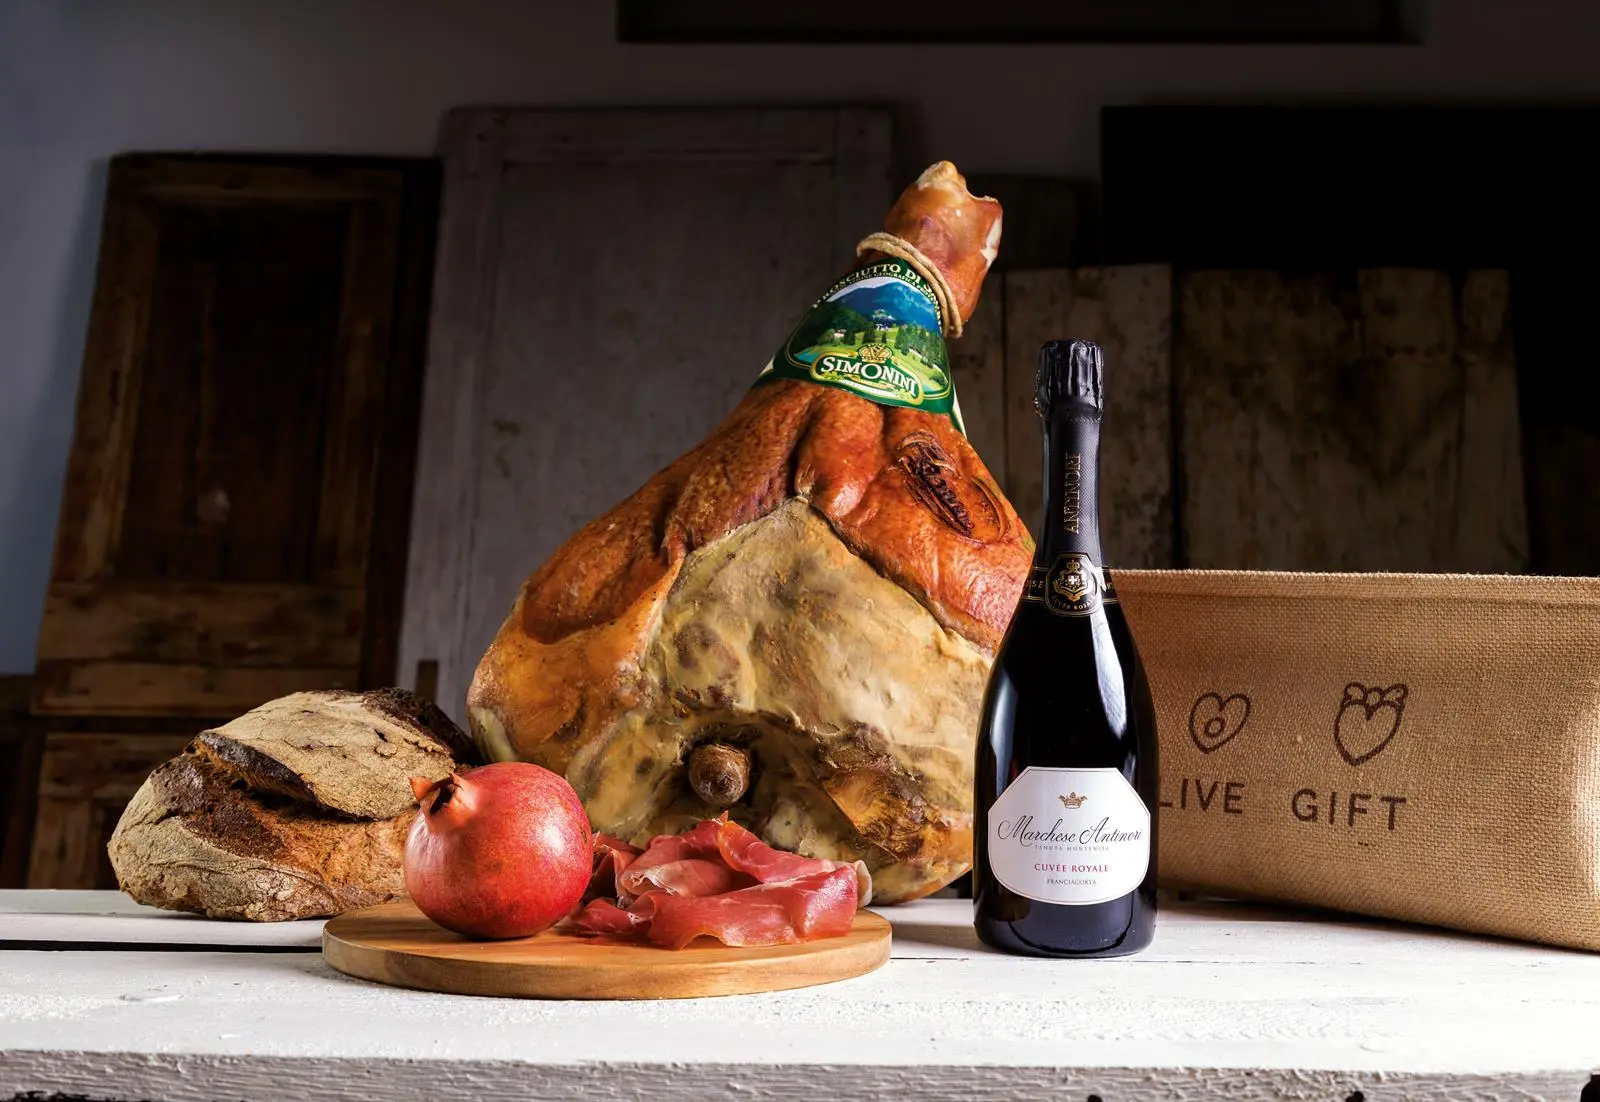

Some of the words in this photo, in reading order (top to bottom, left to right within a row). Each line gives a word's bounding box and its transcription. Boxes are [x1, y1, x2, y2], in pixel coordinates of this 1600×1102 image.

[905, 268, 921, 284] DI
[820, 356, 917, 397] SIMONINI
[1063, 452, 1081, 535] ANTINORI
[1291, 788, 1407, 831] GIFT
[997, 815, 1076, 847] Marchese
[1078, 817, 1143, 845] Antinori
[1034, 862, 1067, 873] CUVÉE
[1071, 864, 1109, 873] ROYALE
[1046, 878, 1097, 886] FRANCIACORTA
